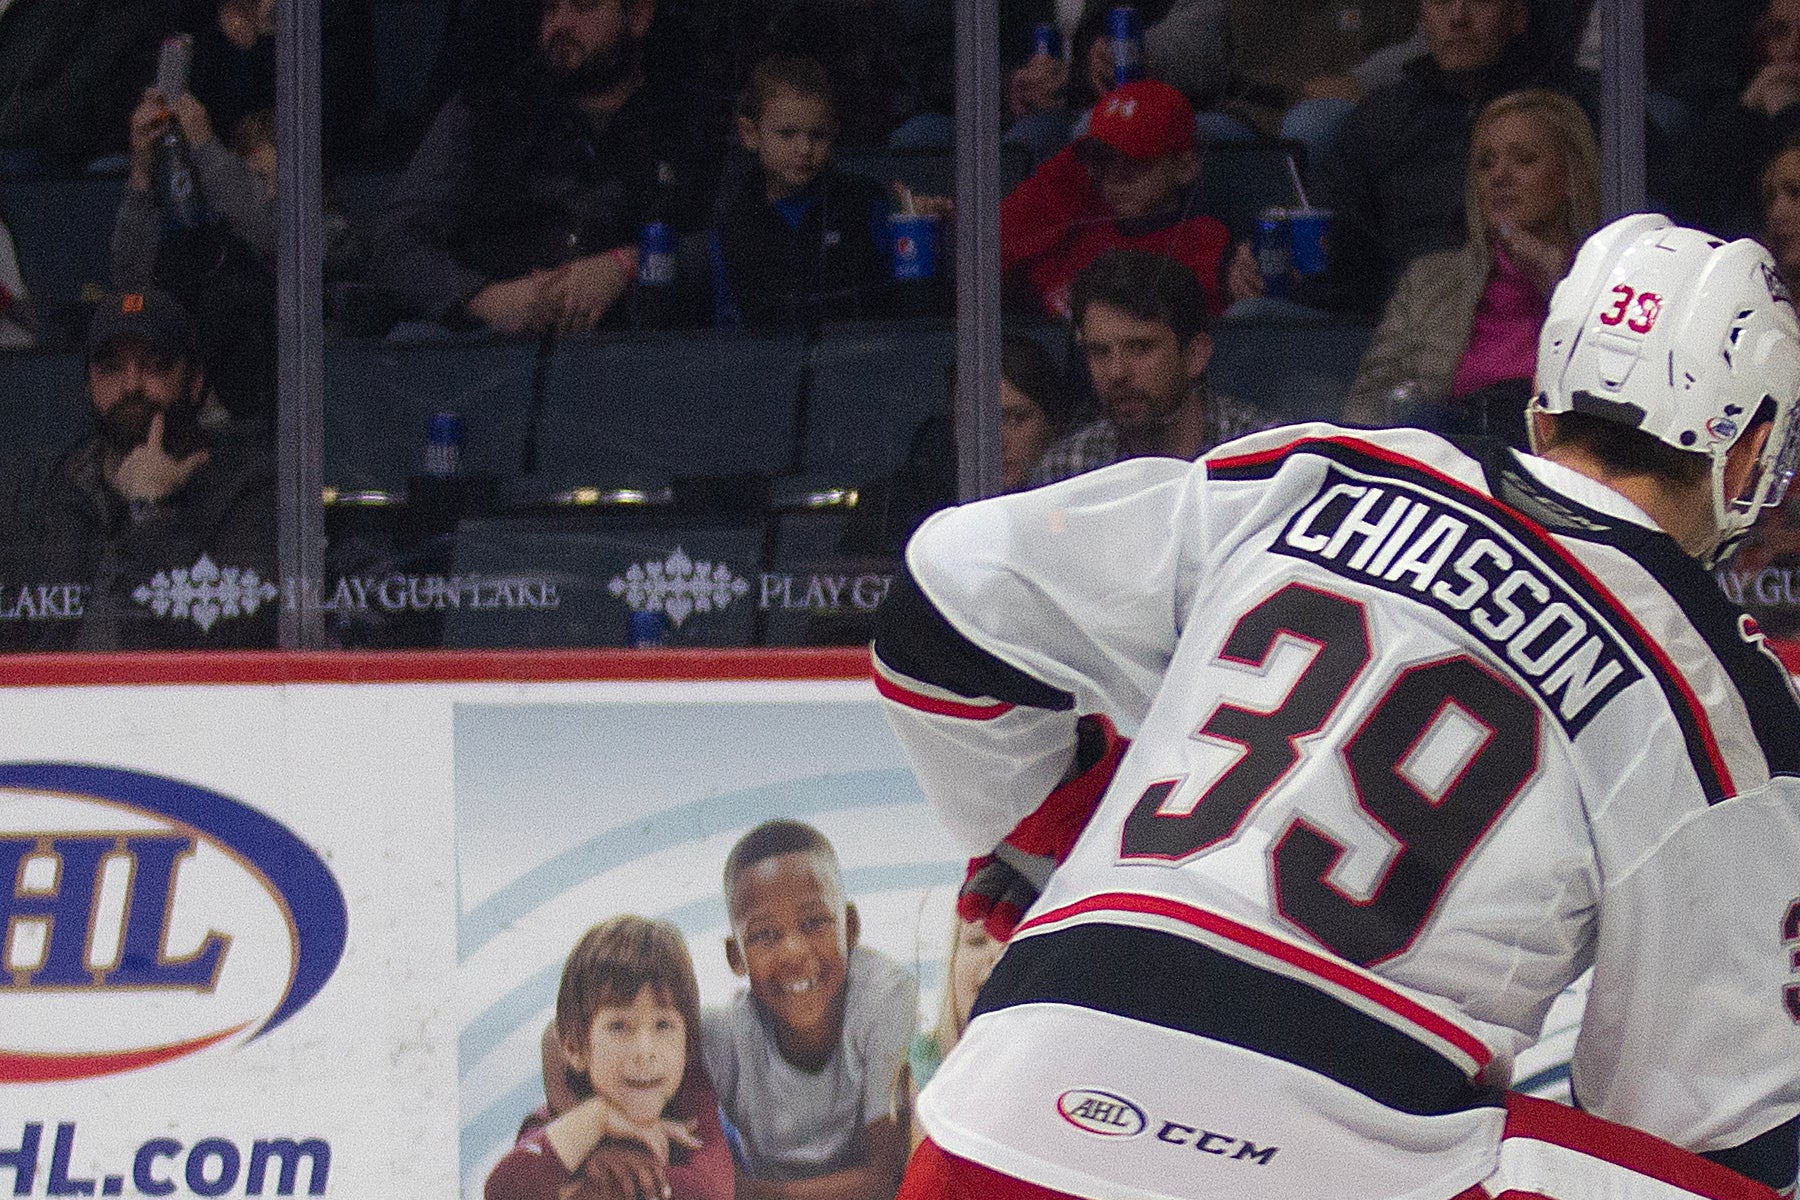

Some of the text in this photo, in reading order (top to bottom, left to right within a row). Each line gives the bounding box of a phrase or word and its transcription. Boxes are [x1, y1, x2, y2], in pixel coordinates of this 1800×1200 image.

[1600, 283, 1663, 334] 39
[759, 573, 847, 609] PLAY
[1286, 483, 1624, 721] CHIASSON
[1115, 577, 1546, 969] 39
[1069, 1098, 1281, 1166] AHL CCM
